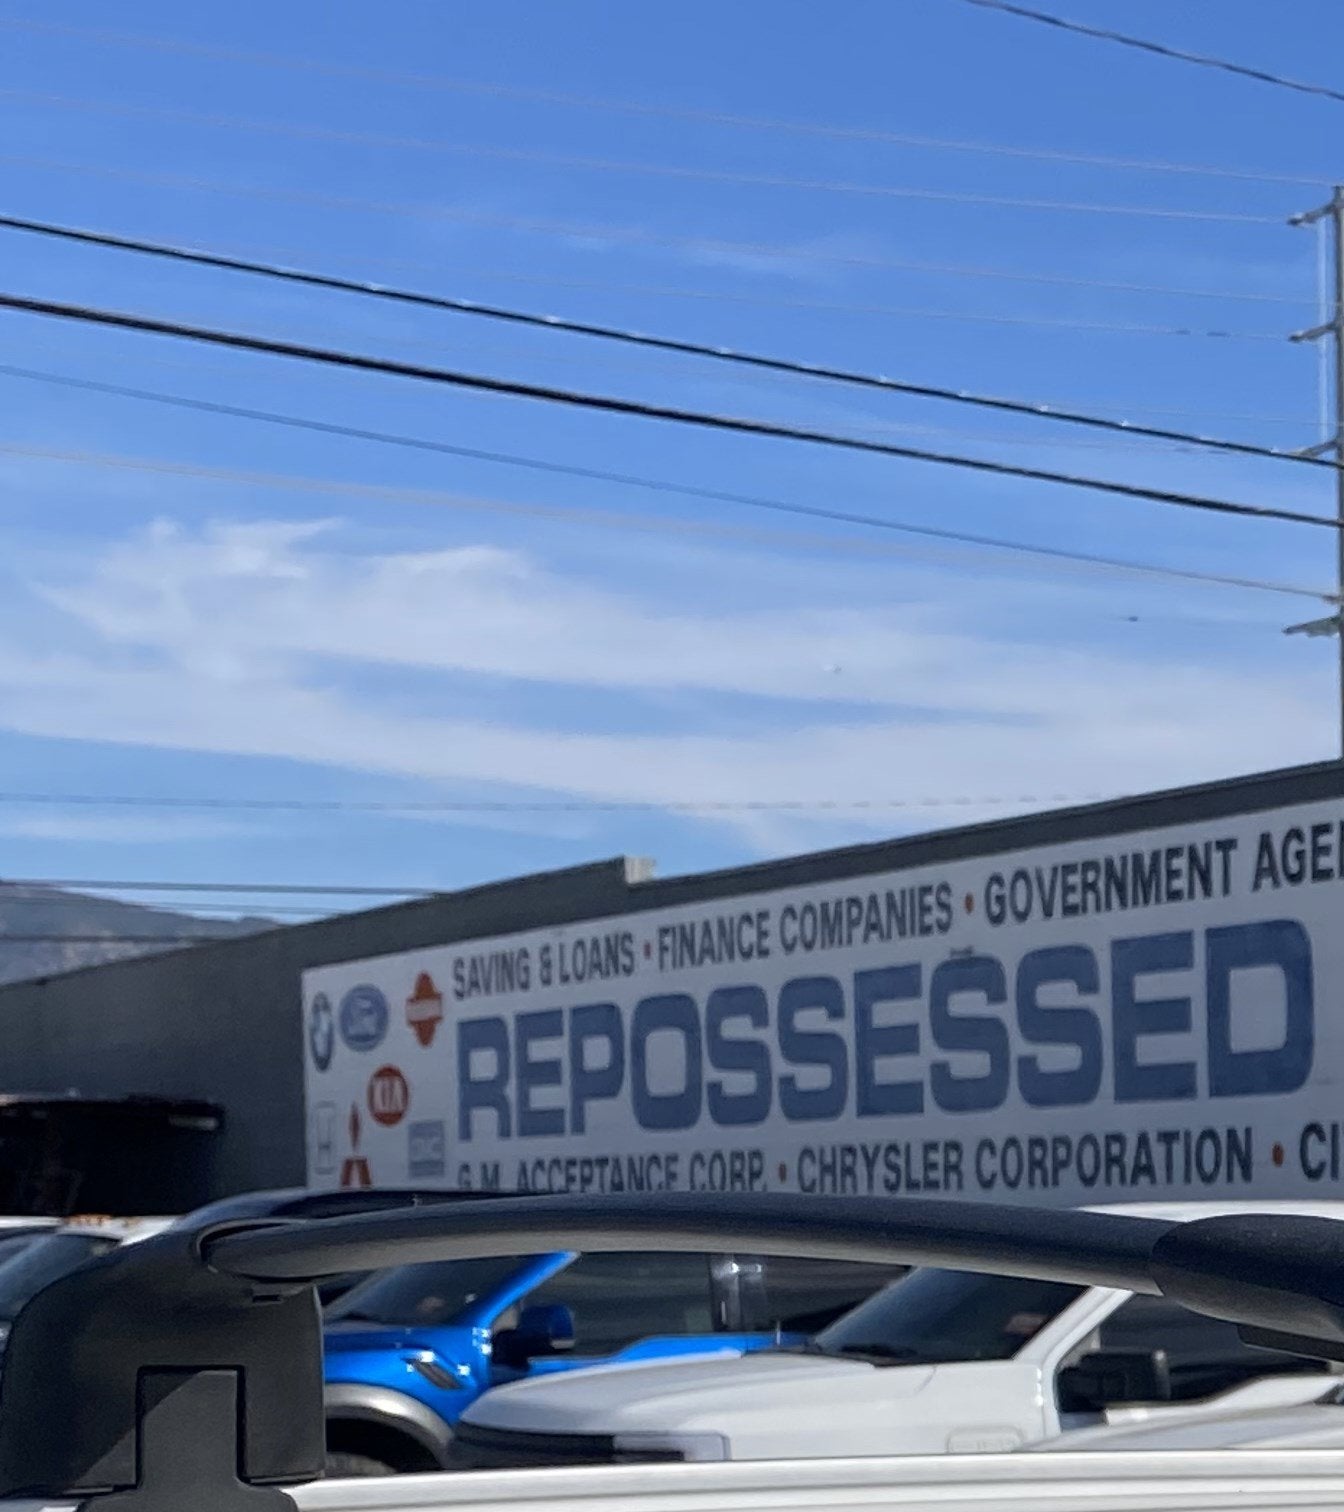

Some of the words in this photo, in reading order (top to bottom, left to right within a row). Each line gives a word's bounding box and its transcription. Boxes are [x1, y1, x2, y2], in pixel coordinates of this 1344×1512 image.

[453, 946, 530, 1000] SAVING
[539, 943, 553, 987] &
[558, 931, 635, 984] LOANS
[658, 910, 771, 971] FINANCE
[779, 881, 953, 955] COMPANIES
[985, 838, 1238, 926] GOVERNMENT
[457, 918, 1315, 1140] REPOSSESSED
[798, 1139, 963, 1193] CHRYSLER
[975, 1127, 1253, 1191] CORPORATION
